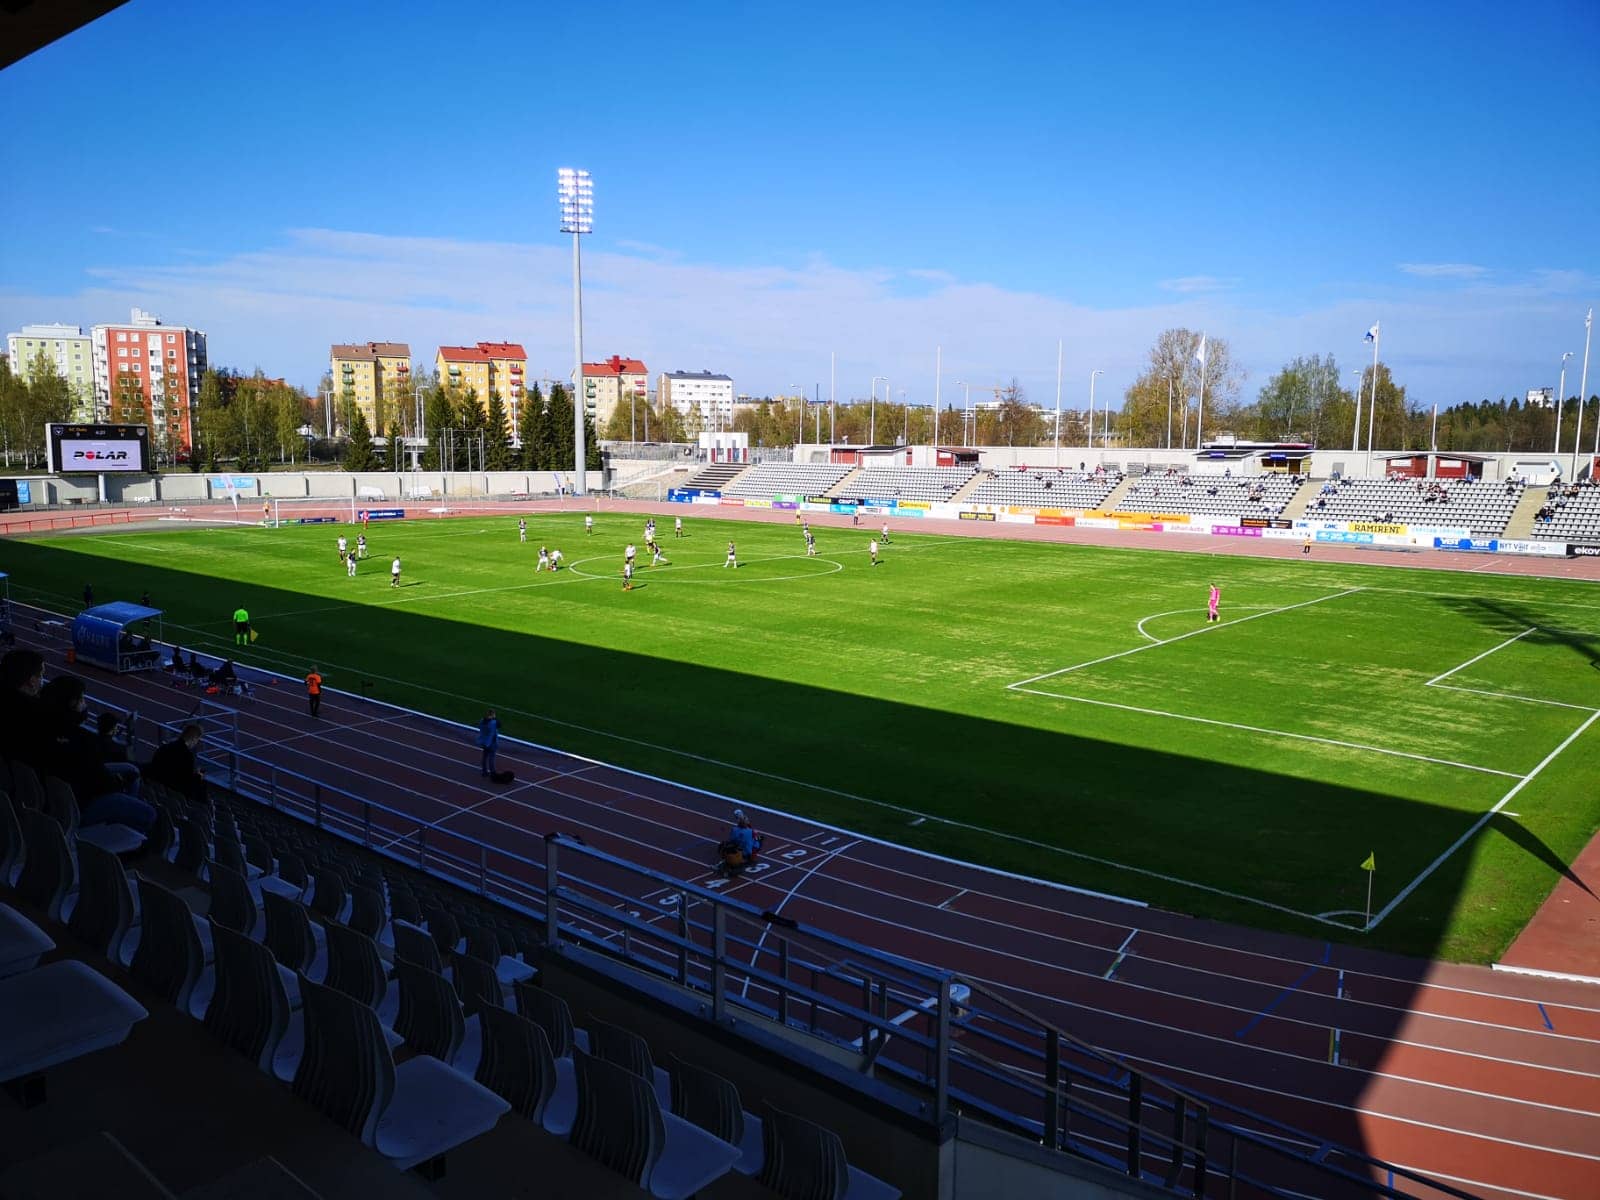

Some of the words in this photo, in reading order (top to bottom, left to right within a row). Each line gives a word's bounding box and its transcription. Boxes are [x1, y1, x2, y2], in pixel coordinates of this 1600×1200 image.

[73, 451, 128, 460] POLAR
[1354, 524, 1401, 534] RAMIRENT
[820, 837, 840, 846] 1
[781, 849, 808, 860] 2
[745, 863, 771, 873] 3
[704, 878, 731, 889] 4
[658, 893, 682, 905] 5
